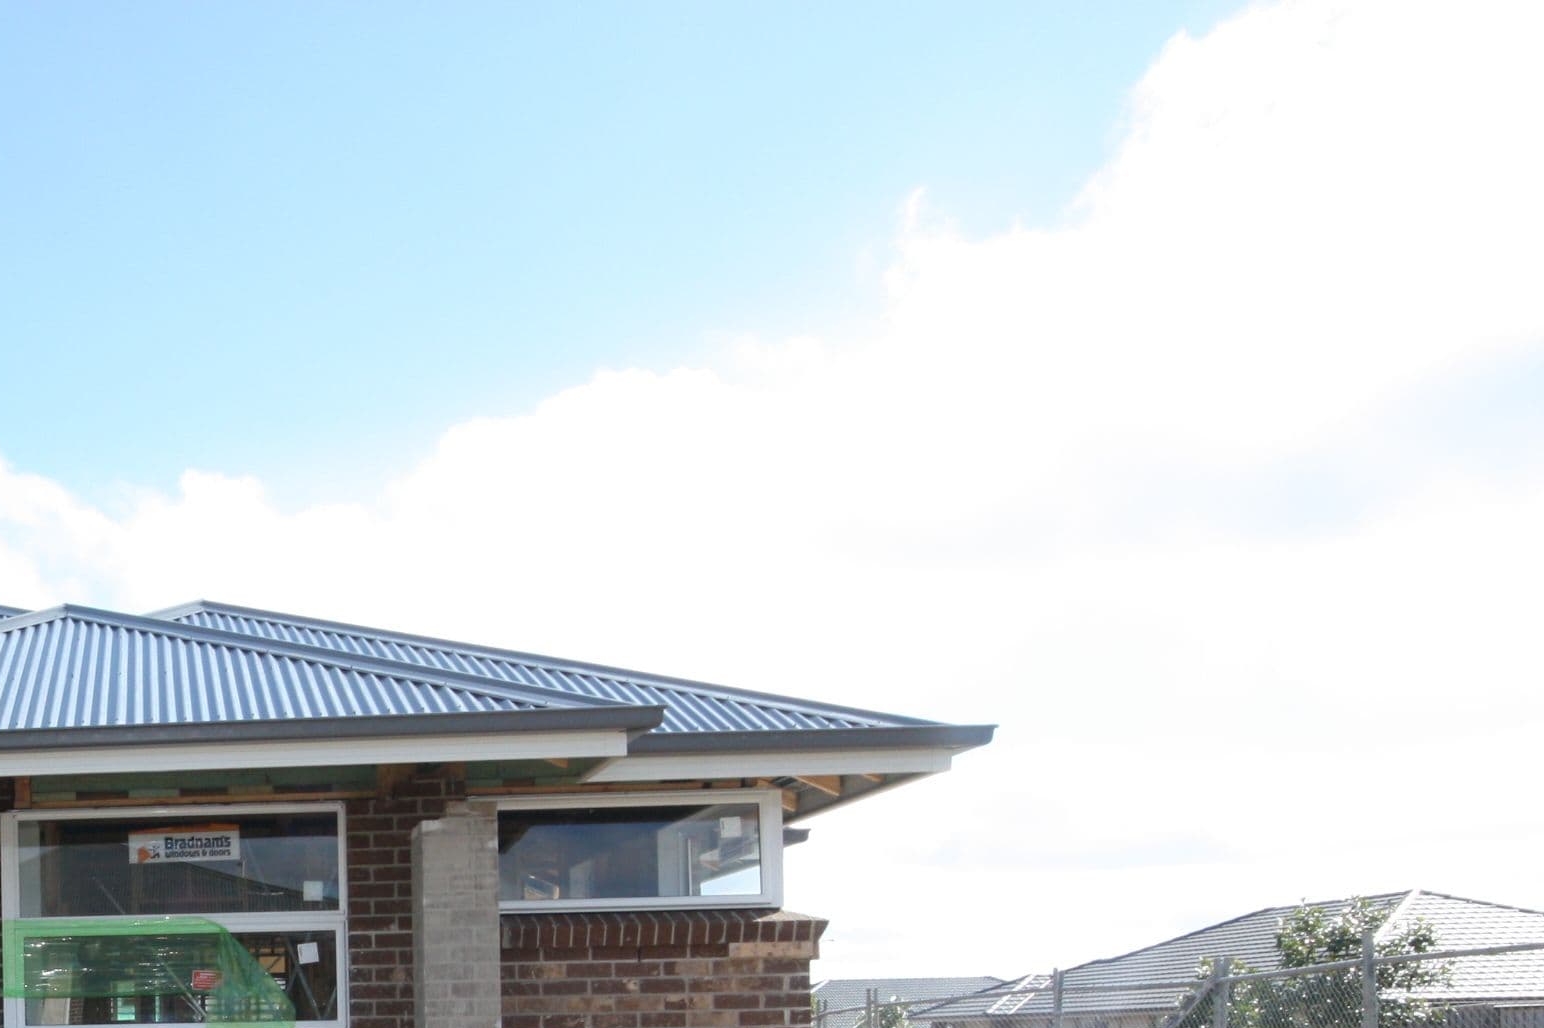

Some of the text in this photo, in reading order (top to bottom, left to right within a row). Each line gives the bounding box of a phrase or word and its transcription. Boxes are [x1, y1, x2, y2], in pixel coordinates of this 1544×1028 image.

[164, 836, 231, 849] Bradnam's
[165, 849, 200, 858] windows
[209, 848, 231, 857] doors
